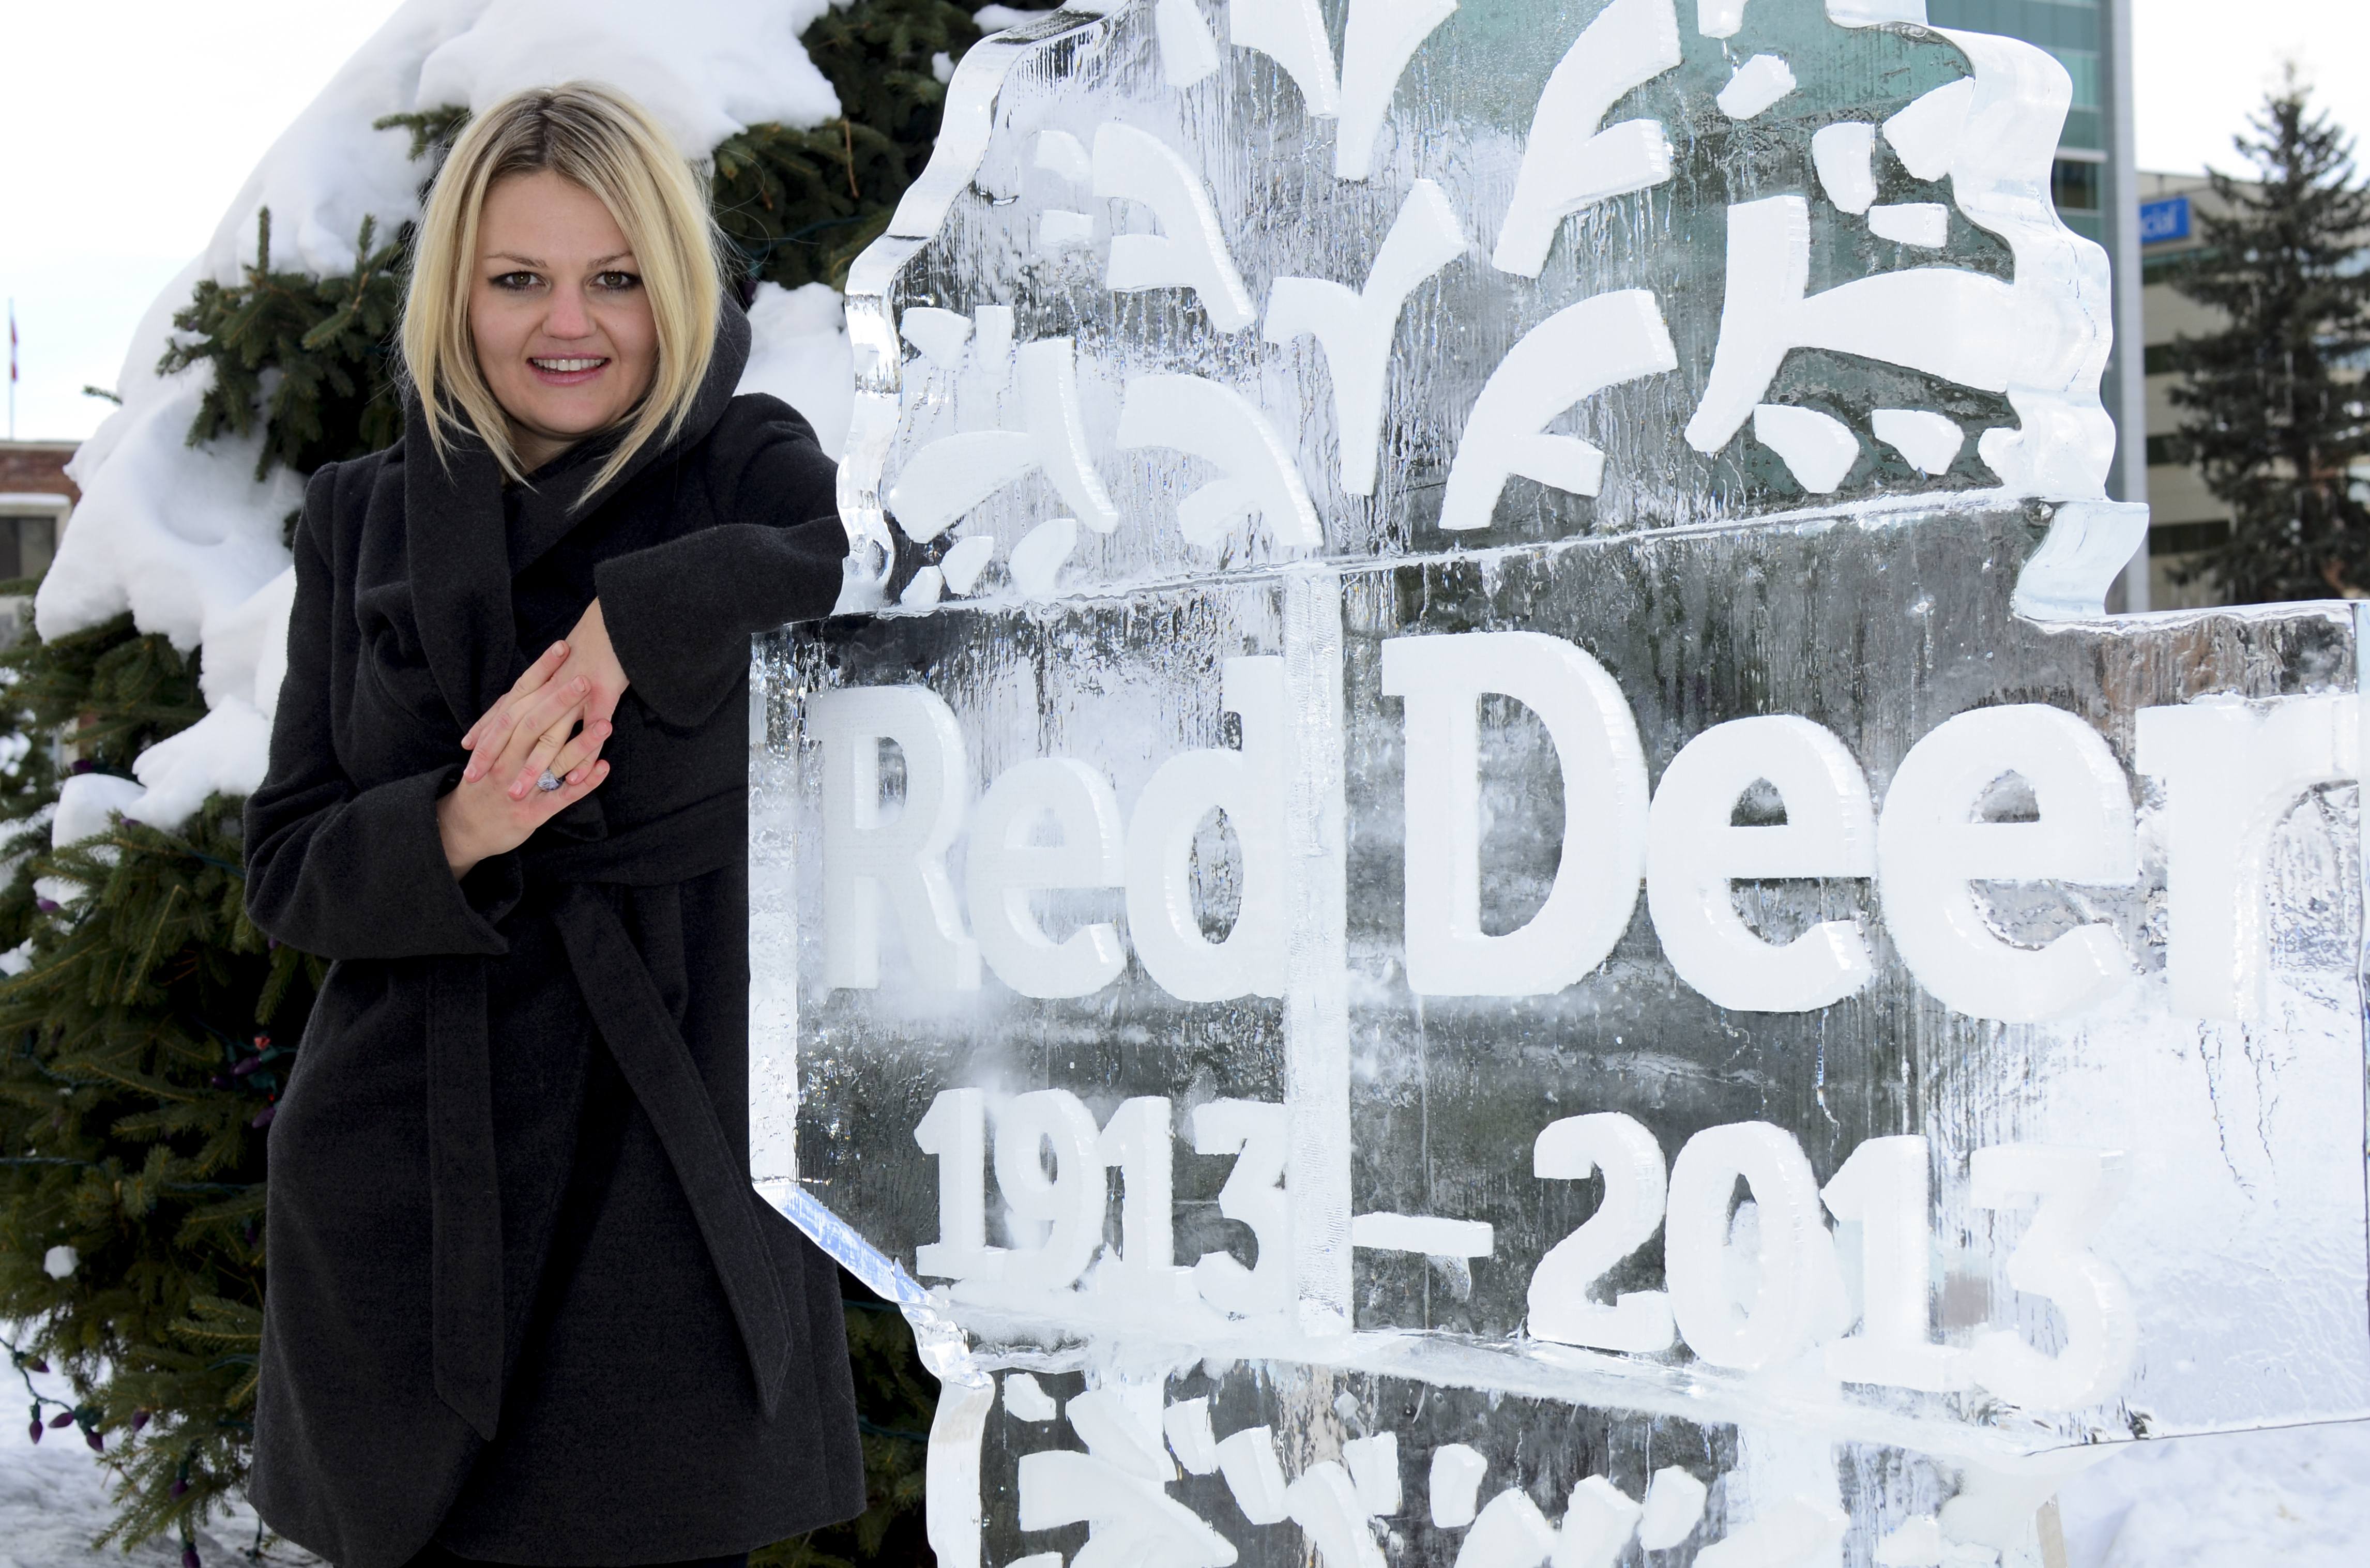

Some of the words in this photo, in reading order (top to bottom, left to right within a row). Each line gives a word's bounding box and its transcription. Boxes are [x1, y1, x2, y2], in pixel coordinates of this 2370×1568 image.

[807, 656, 1284, 1002] Red
[1381, 632, 2359, 1024] Deer
[914, 1087, 1287, 1314] 1913
[1527, 1112, 2137, 1411] 2013
